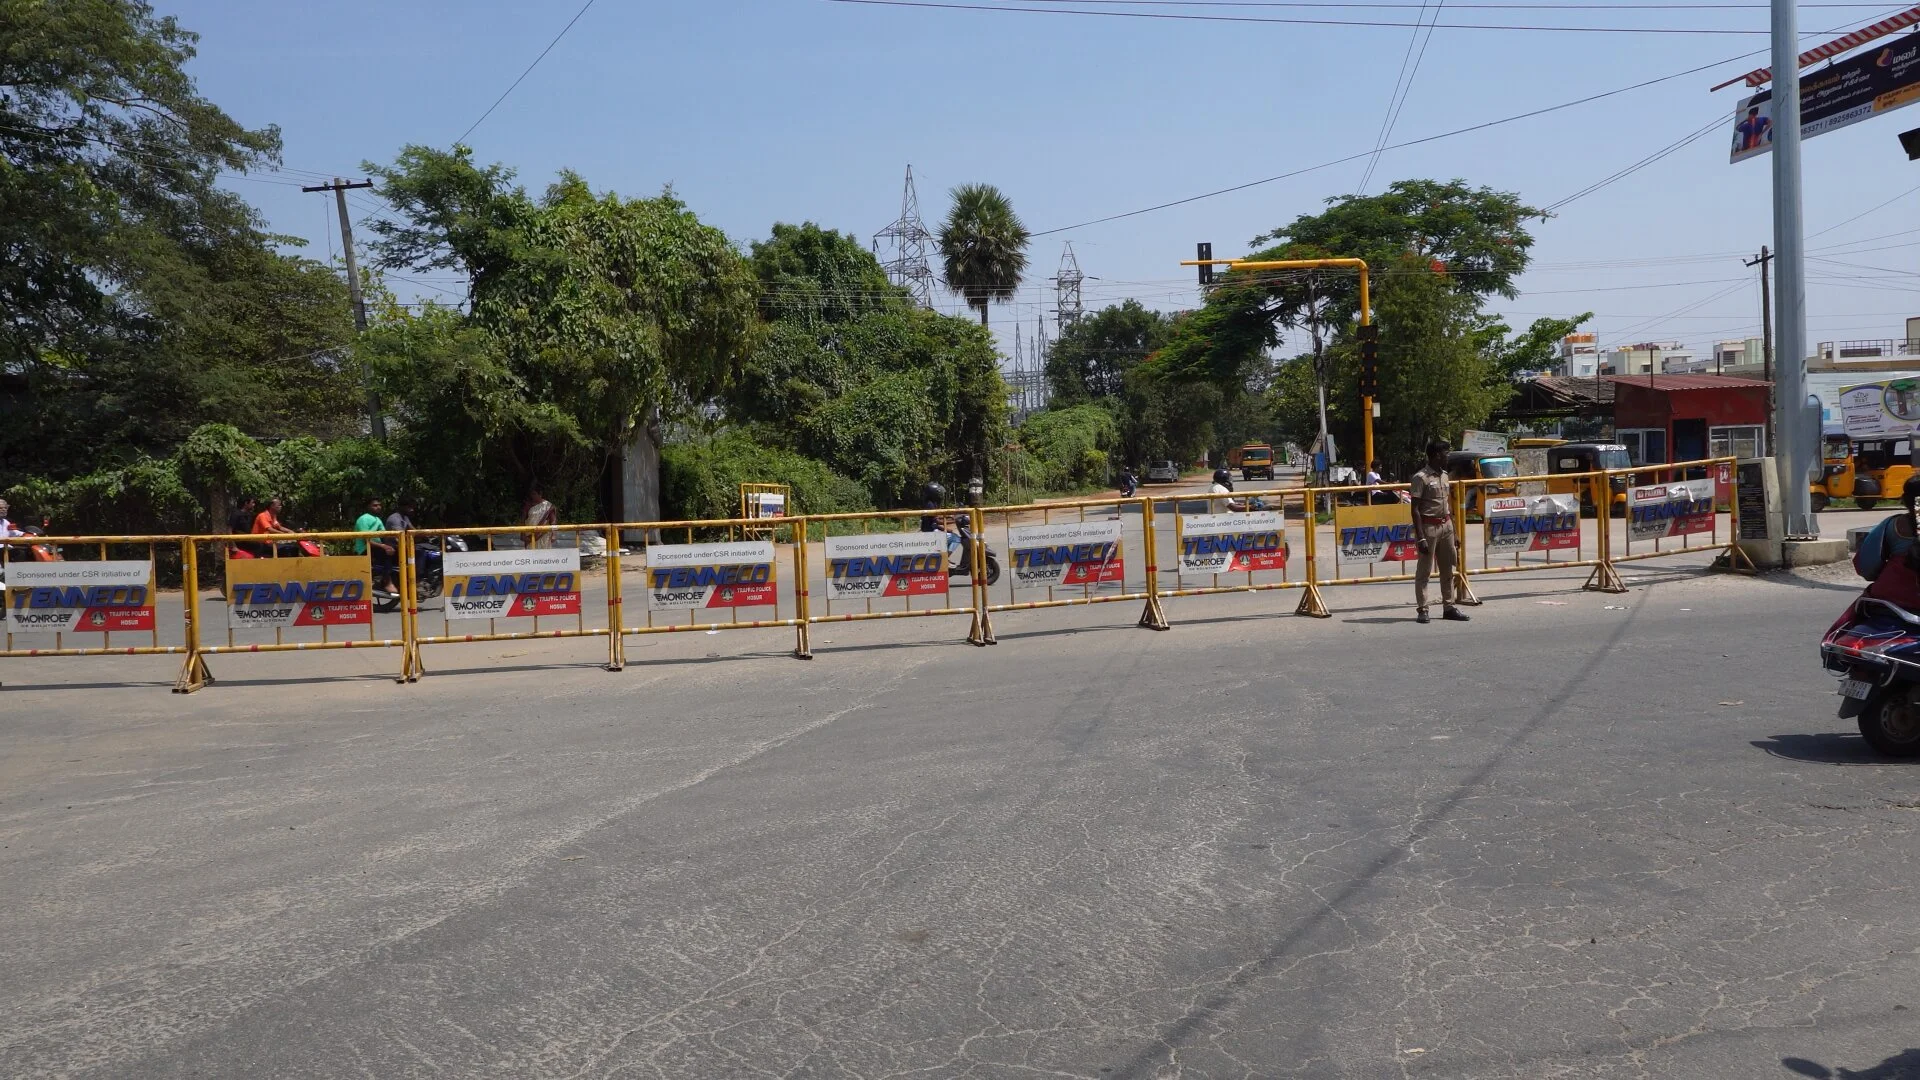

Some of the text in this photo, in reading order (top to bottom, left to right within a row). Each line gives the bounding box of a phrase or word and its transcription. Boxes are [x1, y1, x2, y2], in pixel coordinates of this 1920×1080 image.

[1645, 488, 1666, 497] PARKING
[1491, 513, 1576, 535] TENNECO
[1019, 534, 1049, 542] Sponsored
[1341, 524, 1417, 545] TENNEC
[1183, 531, 1280, 555] TENNECO
[1014, 542, 1118, 567] TENNECO
[1347, 548, 1378, 557] MONROE
[830, 553, 942, 578] TENNECO
[1189, 559, 1221, 568] MONROE
[653, 564, 770, 588] TENNECO
[1021, 570, 1057, 580] MONROE
[839, 582, 876, 591] MONROE
[13, 585, 148, 608] TENNECO
[233, 581, 364, 605] TENNECO
[659, 591, 699, 601] MONROE
[458, 600, 499, 610] MONROE
[20, 614, 66, 623] MONROE
[242, 609, 287, 619] MONROE
